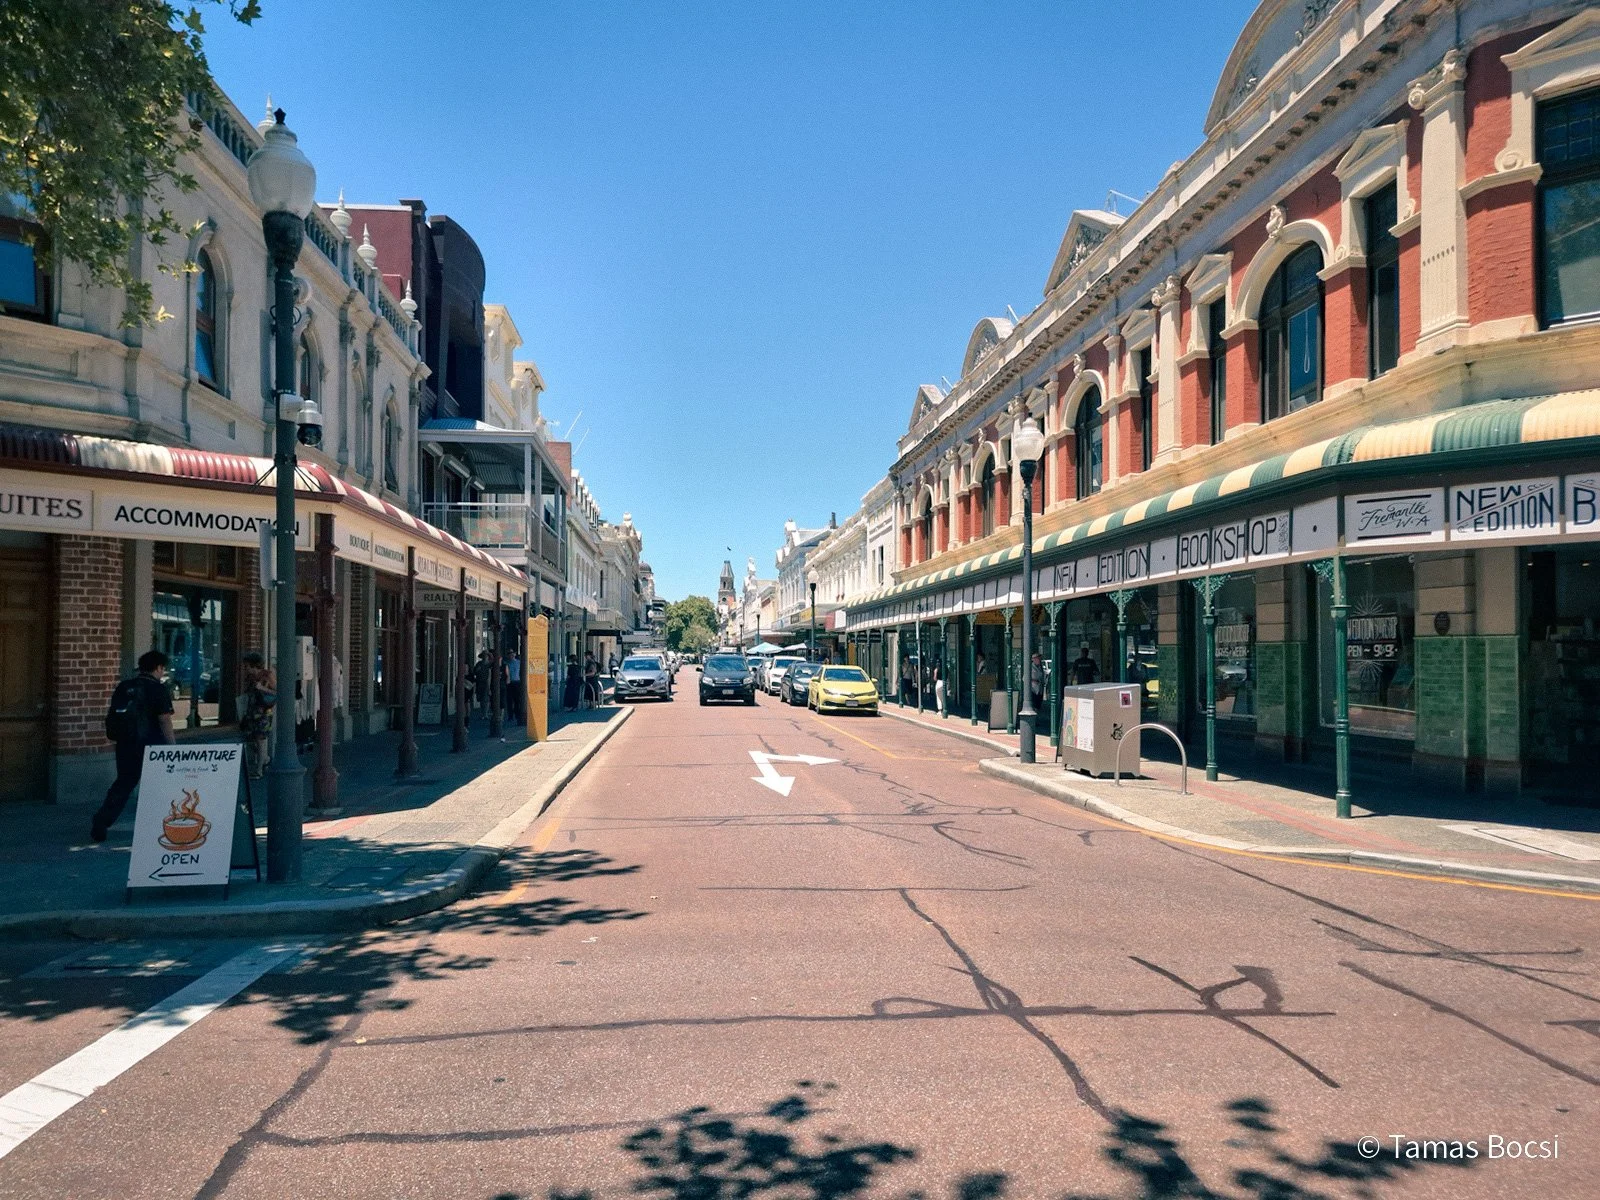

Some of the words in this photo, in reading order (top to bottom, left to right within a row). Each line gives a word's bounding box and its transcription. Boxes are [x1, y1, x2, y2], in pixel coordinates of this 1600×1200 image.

[1358, 502, 1431, 531] Fremantle
[1457, 485, 1521, 520] NEW
[1474, 488, 1554, 532] EDITION
[1573, 487, 1596, 525] B
[115, 505, 299, 537] ACCOMMODAT
[1055, 565, 1077, 591] NEW
[1100, 545, 1150, 583] EDITION
[1180, 517, 1277, 568] BOOKSHOP
[1346, 645, 1362, 658] PEN
[149, 749, 238, 763] DARAWNATURE
[161, 852, 200, 866] OPEN
